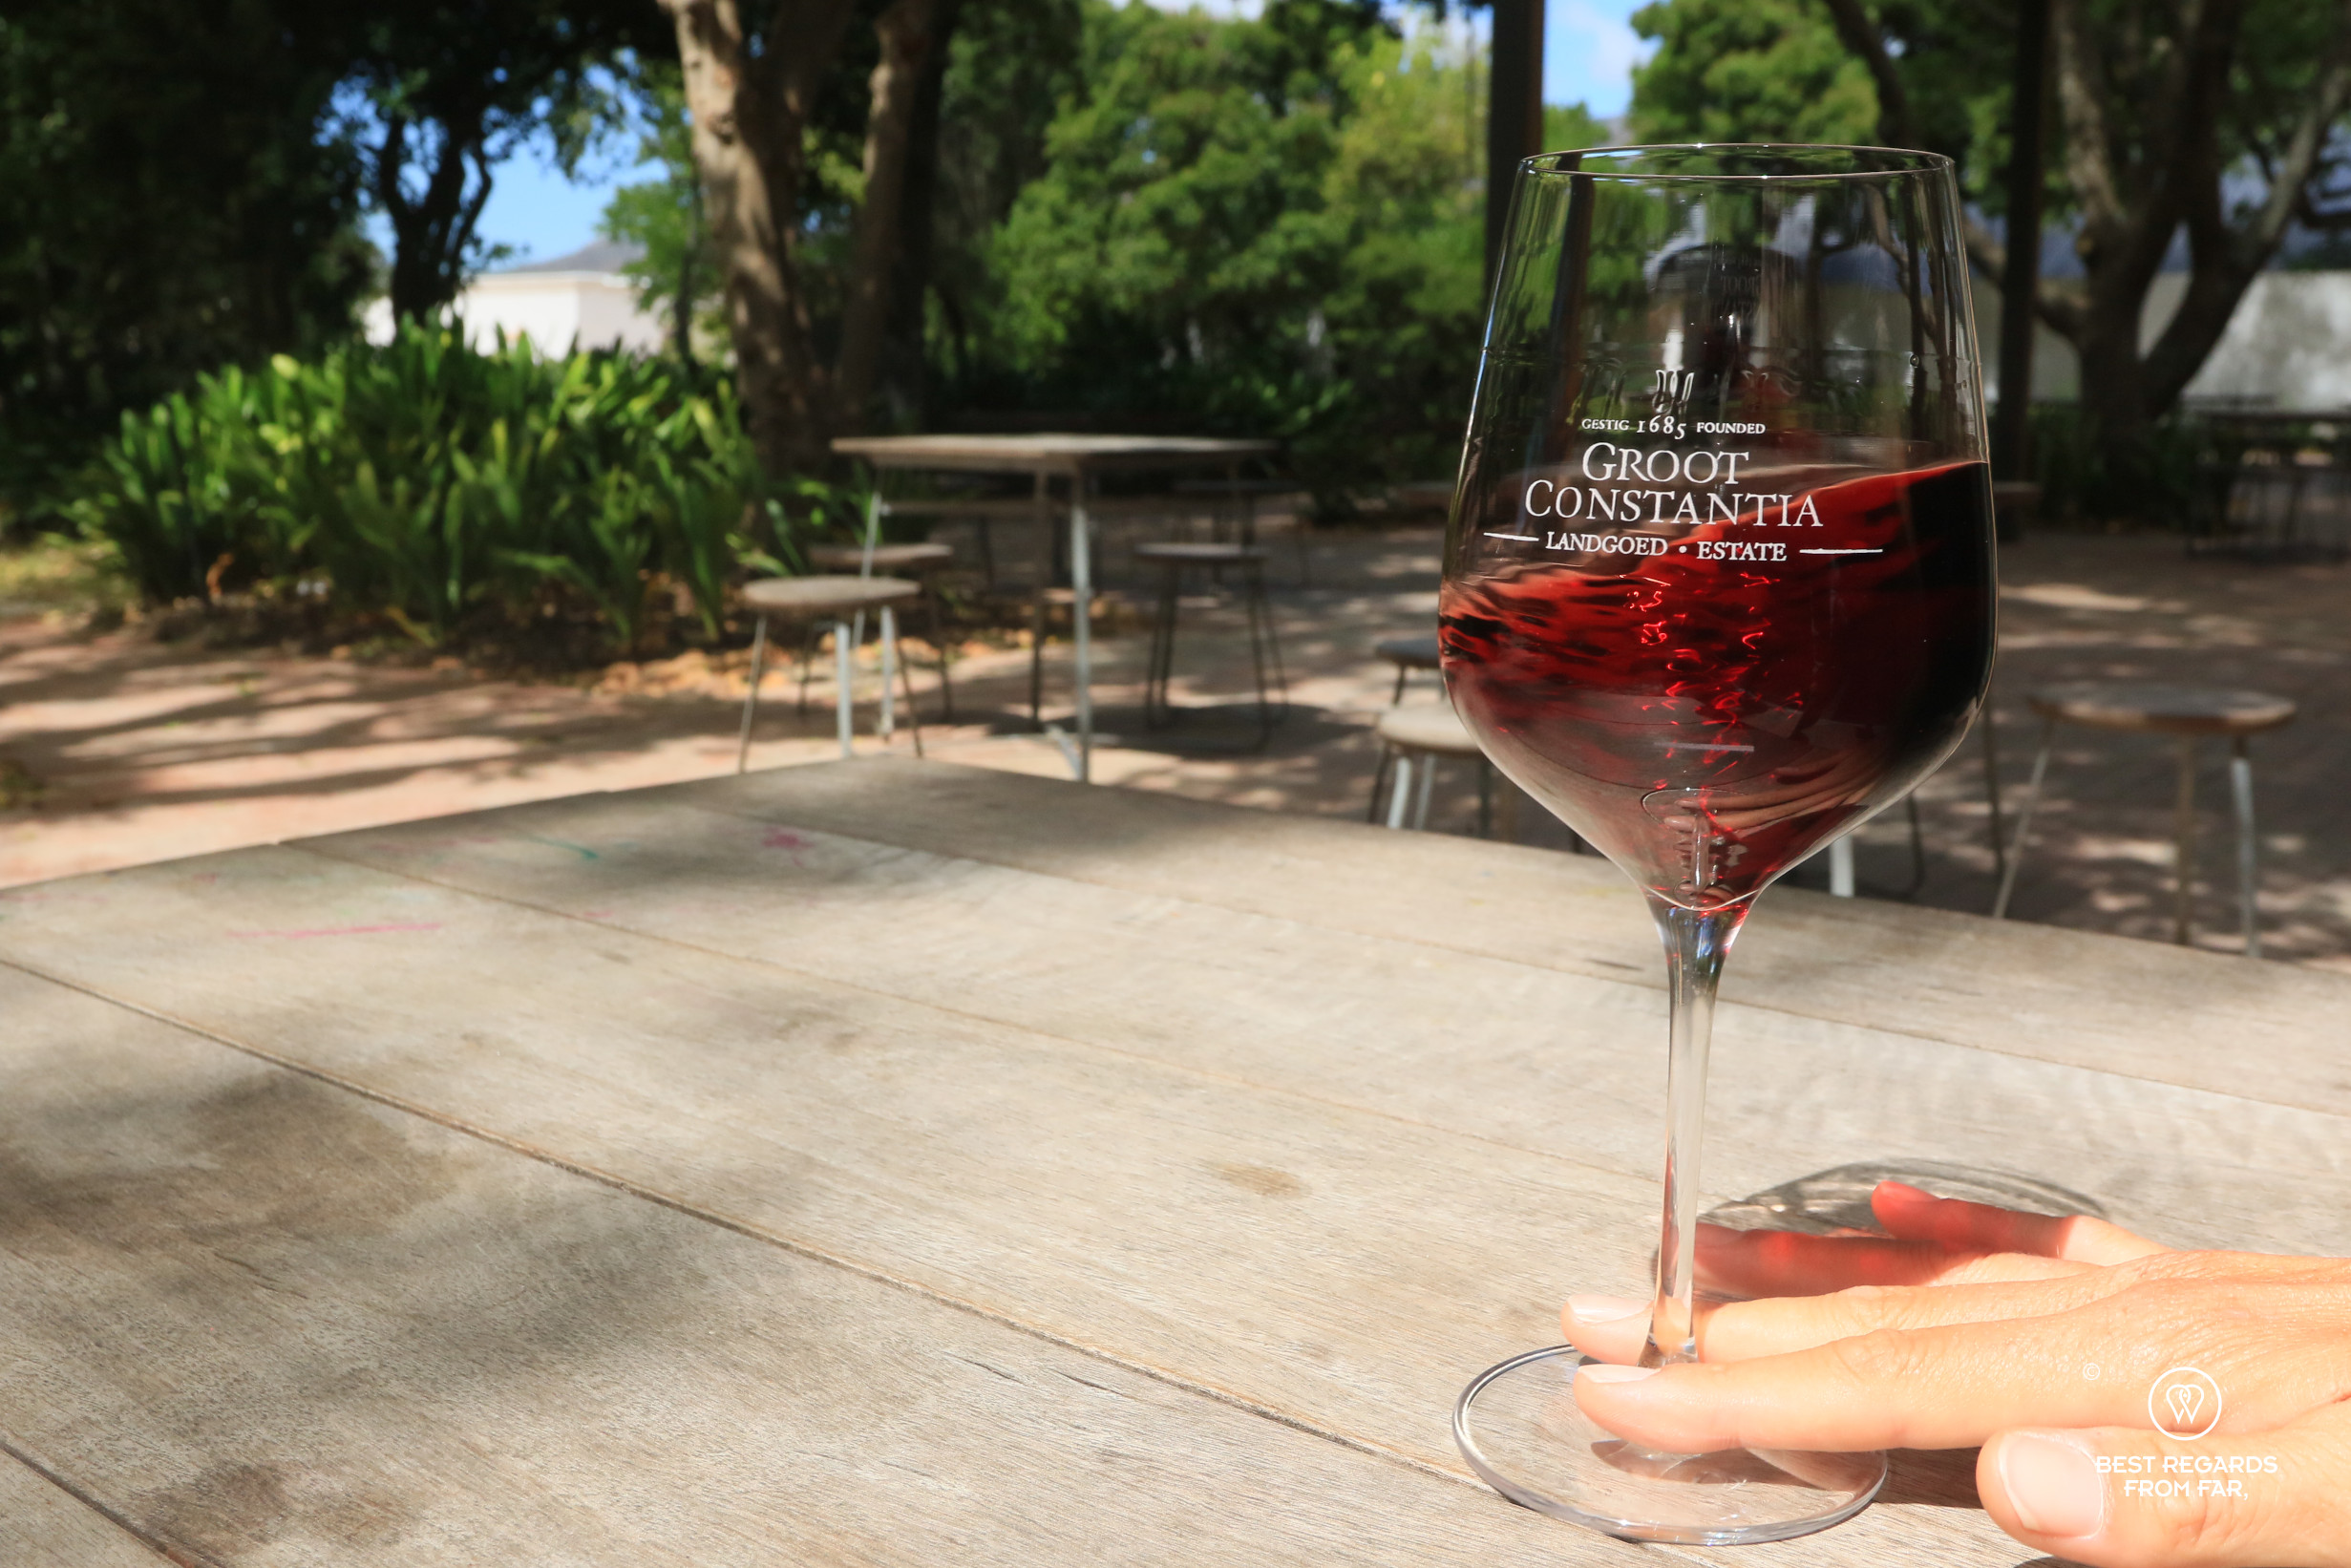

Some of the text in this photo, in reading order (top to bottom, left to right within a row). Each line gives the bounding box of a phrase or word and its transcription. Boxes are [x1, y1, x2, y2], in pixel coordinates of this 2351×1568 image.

[1581, 415, 1767, 440] GESTIG 1685 FOUNDED
[1581, 441, 1749, 485] GROOT
[1524, 479, 1824, 527] CONSTANTIA
[1544, 531, 1788, 562] LANDGOED ESTATE
